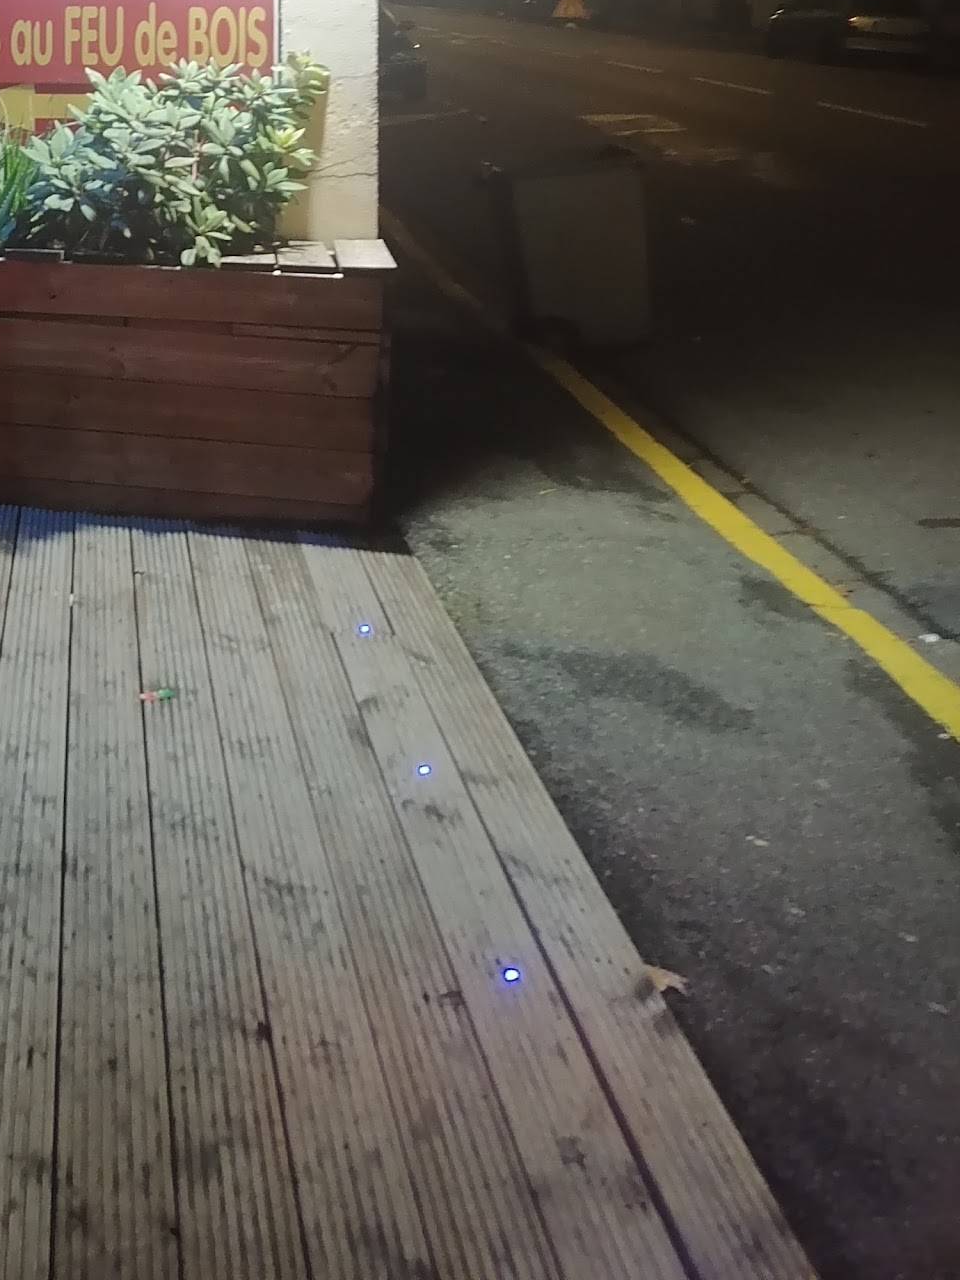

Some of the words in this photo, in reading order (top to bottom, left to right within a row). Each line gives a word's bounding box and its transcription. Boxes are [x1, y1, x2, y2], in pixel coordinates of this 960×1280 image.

[10, 18, 53, 66] au
[64, 5, 124, 67] FEU
[134, 1, 178, 67] de
[187, 5, 269, 68] BOIS
